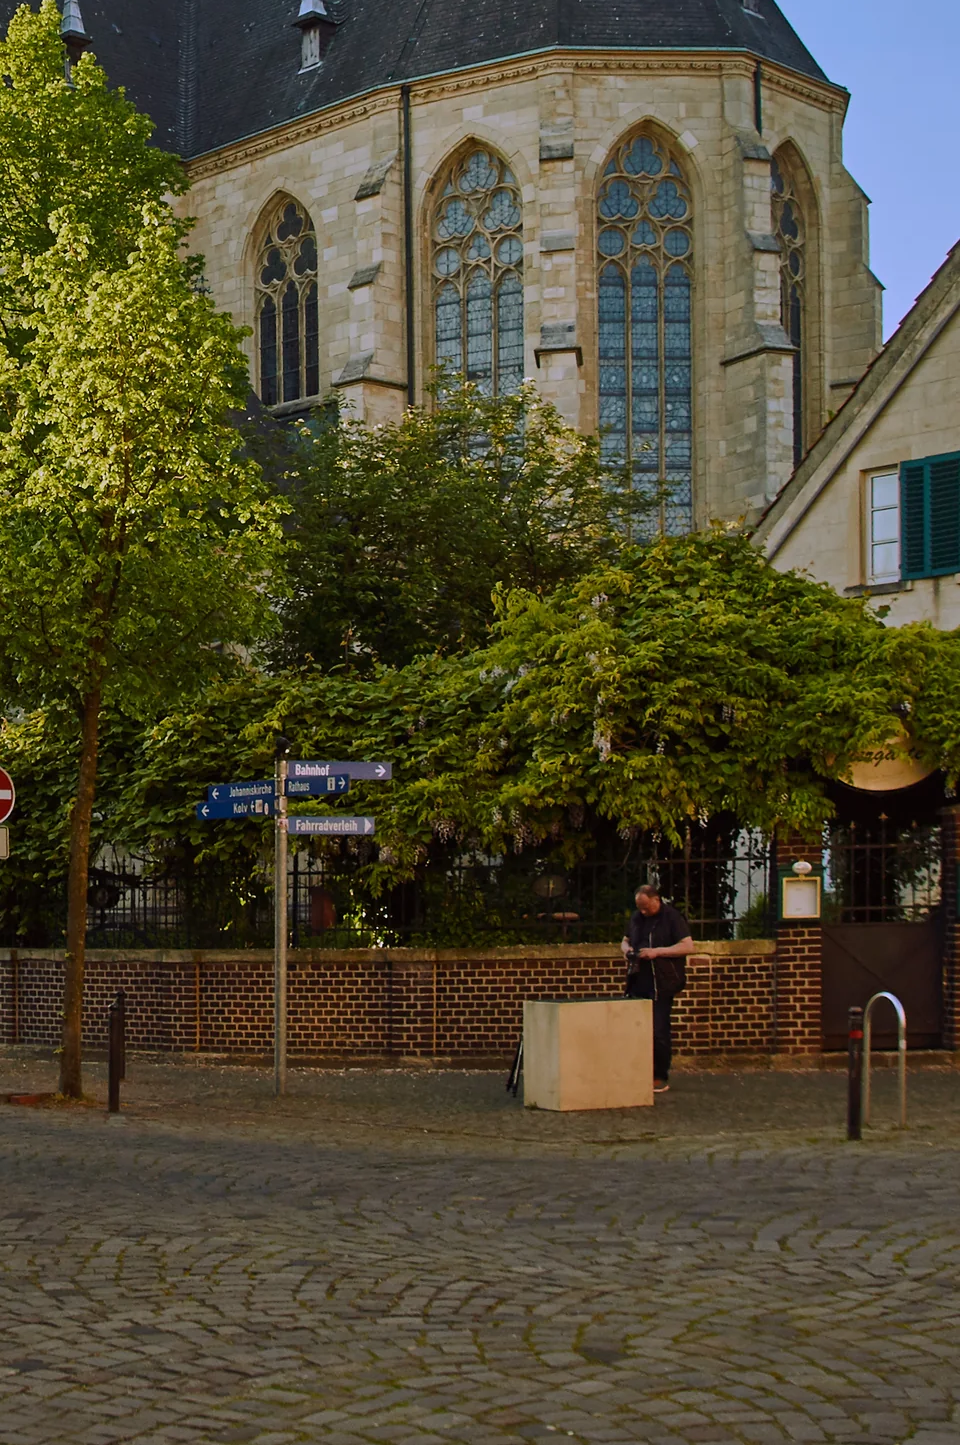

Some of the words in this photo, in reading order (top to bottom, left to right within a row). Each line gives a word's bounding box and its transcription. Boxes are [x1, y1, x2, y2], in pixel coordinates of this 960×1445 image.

[295, 764, 330, 776] Bahnhof
[229, 784, 272, 797] Johanniskirche
[288, 781, 310, 792] Rathaus
[296, 819, 358, 832] Fahrradverleih
